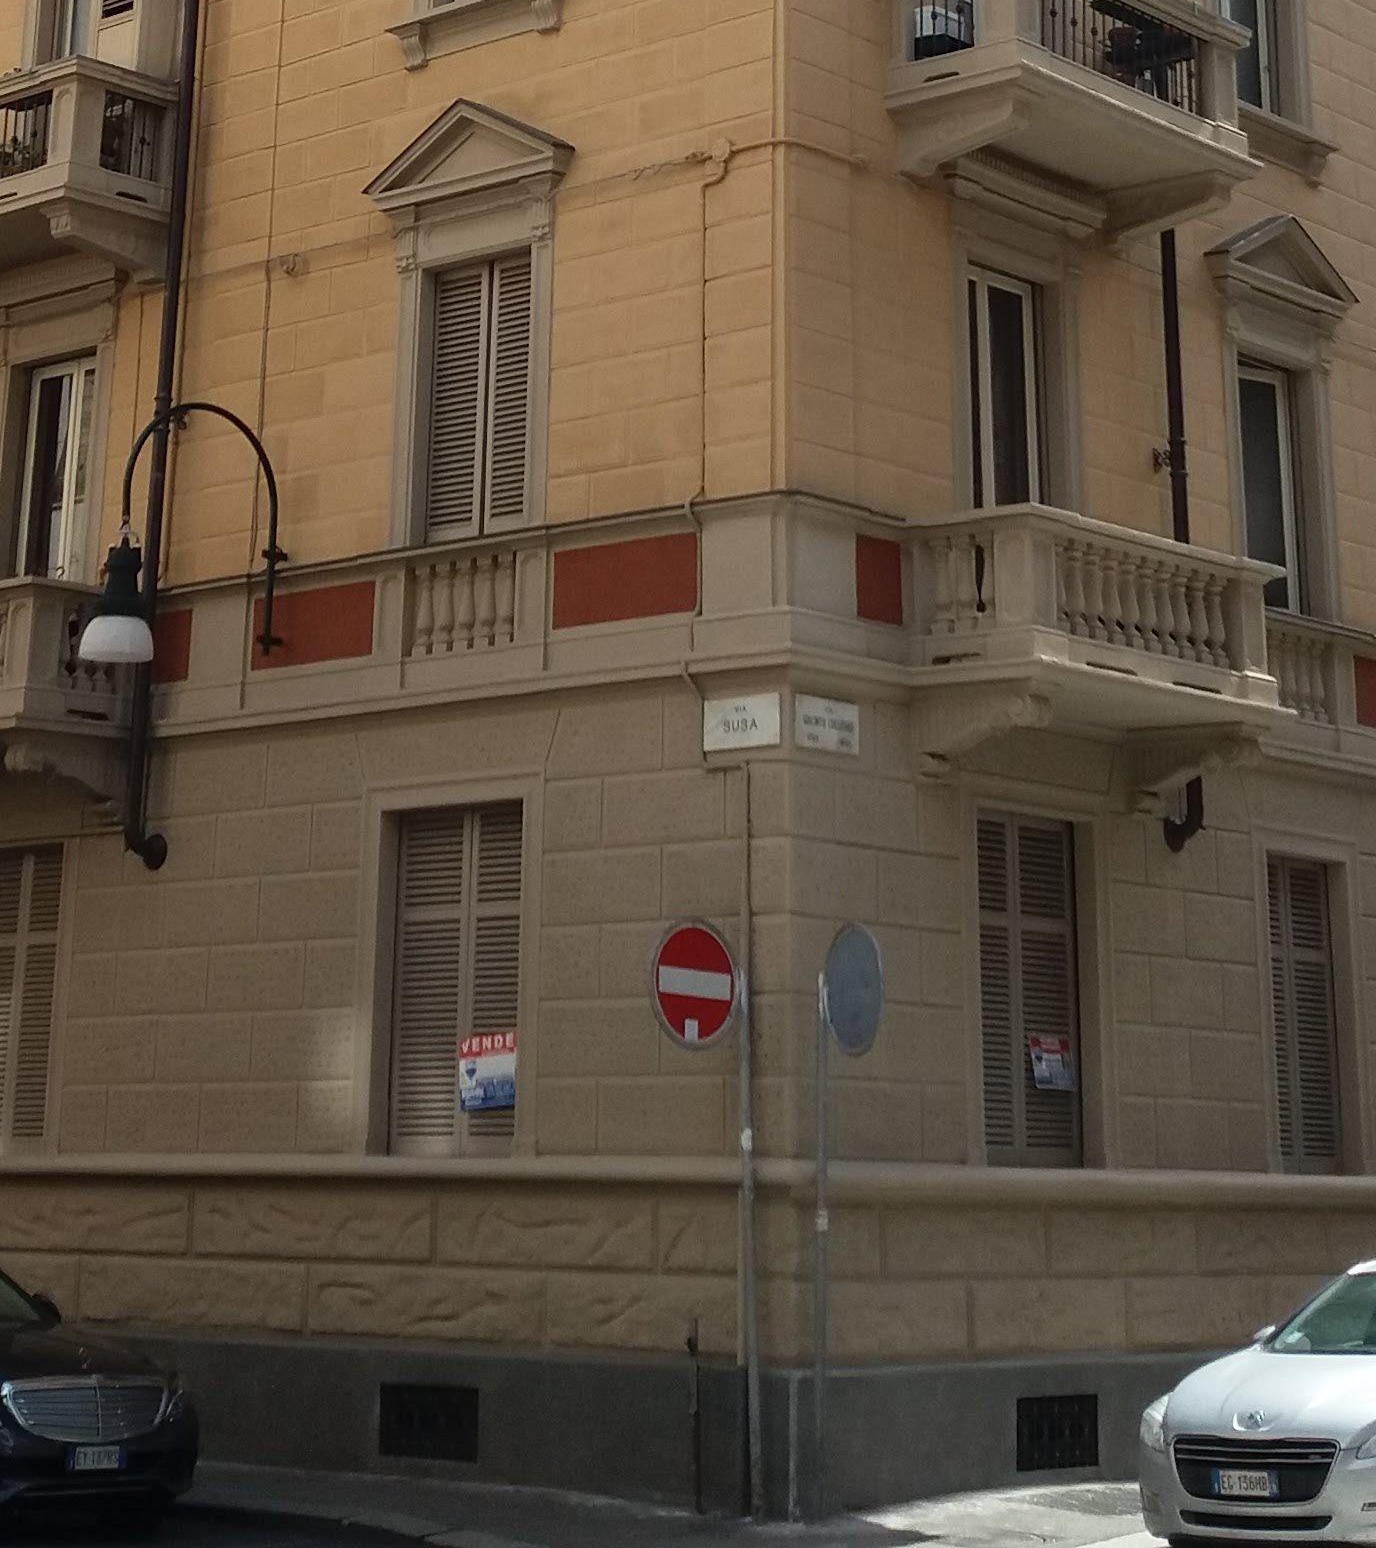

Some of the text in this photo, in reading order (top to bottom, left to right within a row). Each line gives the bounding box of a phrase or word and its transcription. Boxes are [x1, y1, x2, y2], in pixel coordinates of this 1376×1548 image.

[734, 705, 747, 713] VIA
[722, 717, 758, 734] SUSA
[460, 1032, 515, 1054] VENDE
